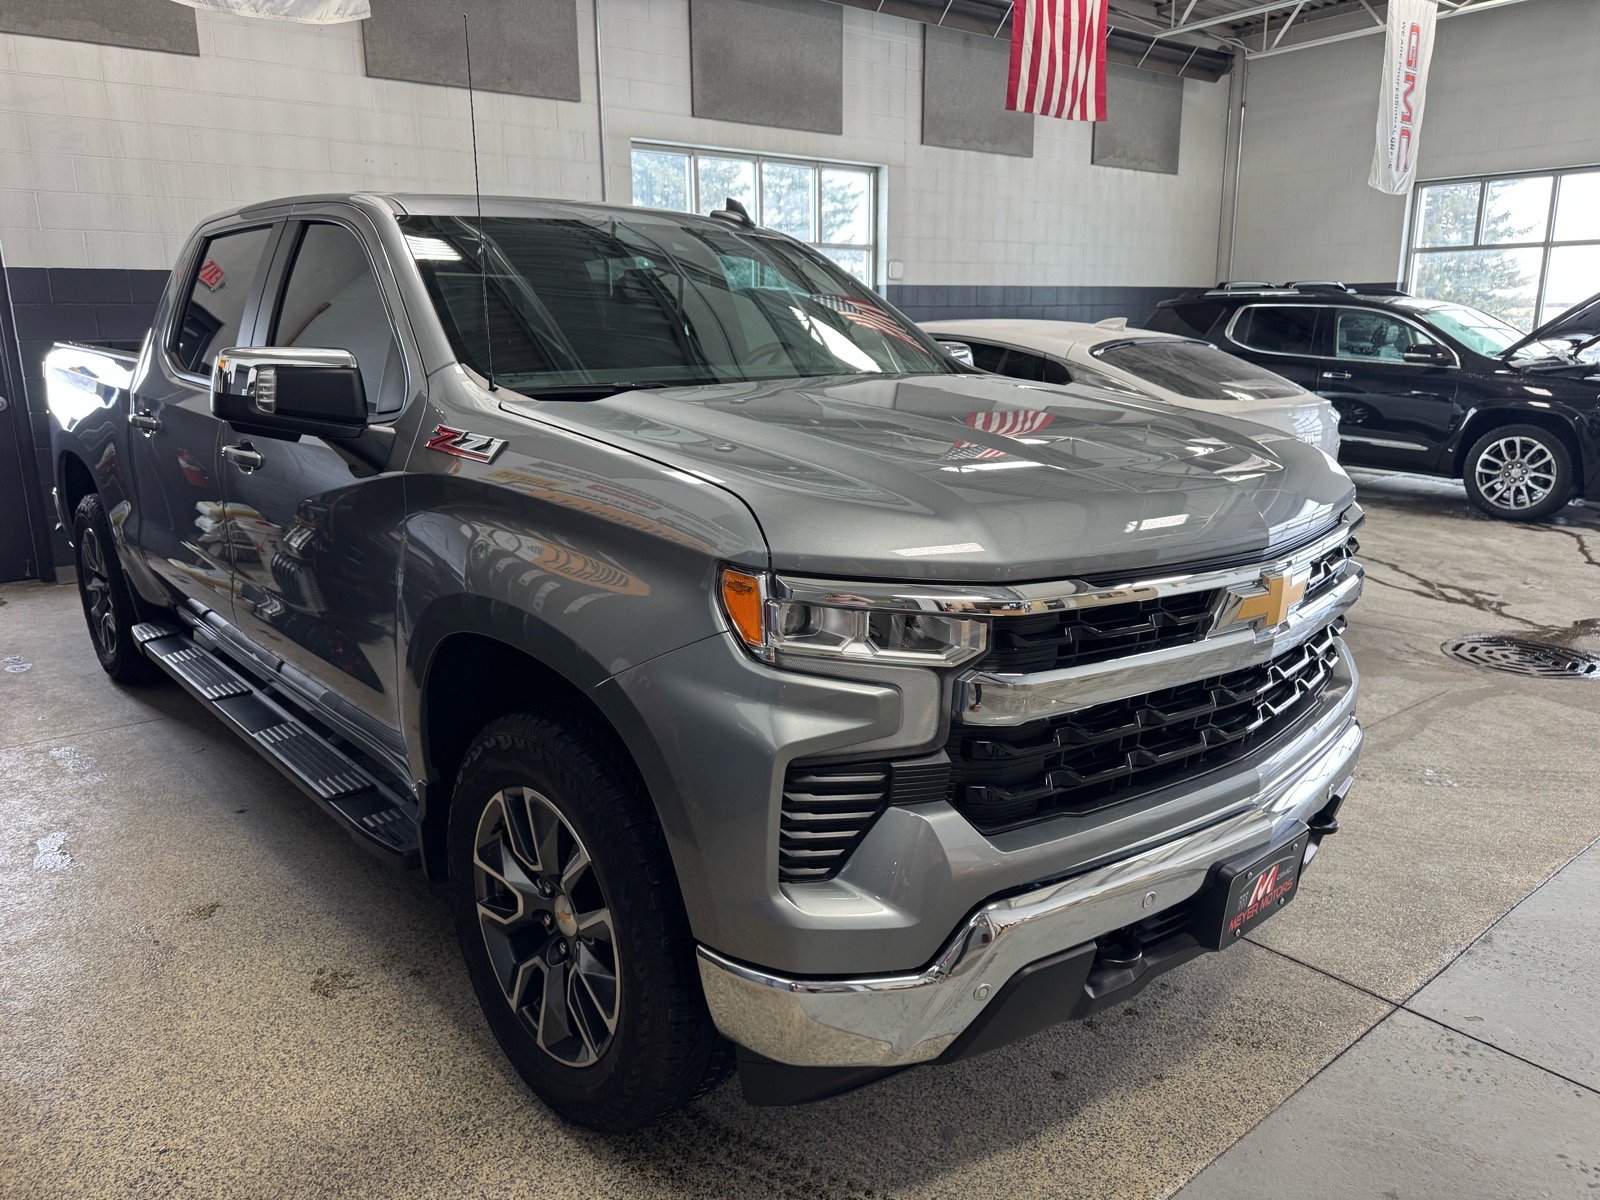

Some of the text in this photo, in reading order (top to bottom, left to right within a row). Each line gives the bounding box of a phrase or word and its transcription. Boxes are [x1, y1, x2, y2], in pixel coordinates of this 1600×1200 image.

[1395, 22, 1420, 172] GMC
[424, 423, 509, 465] Z71
[1228, 879, 1294, 933] MEYER MOTORS
